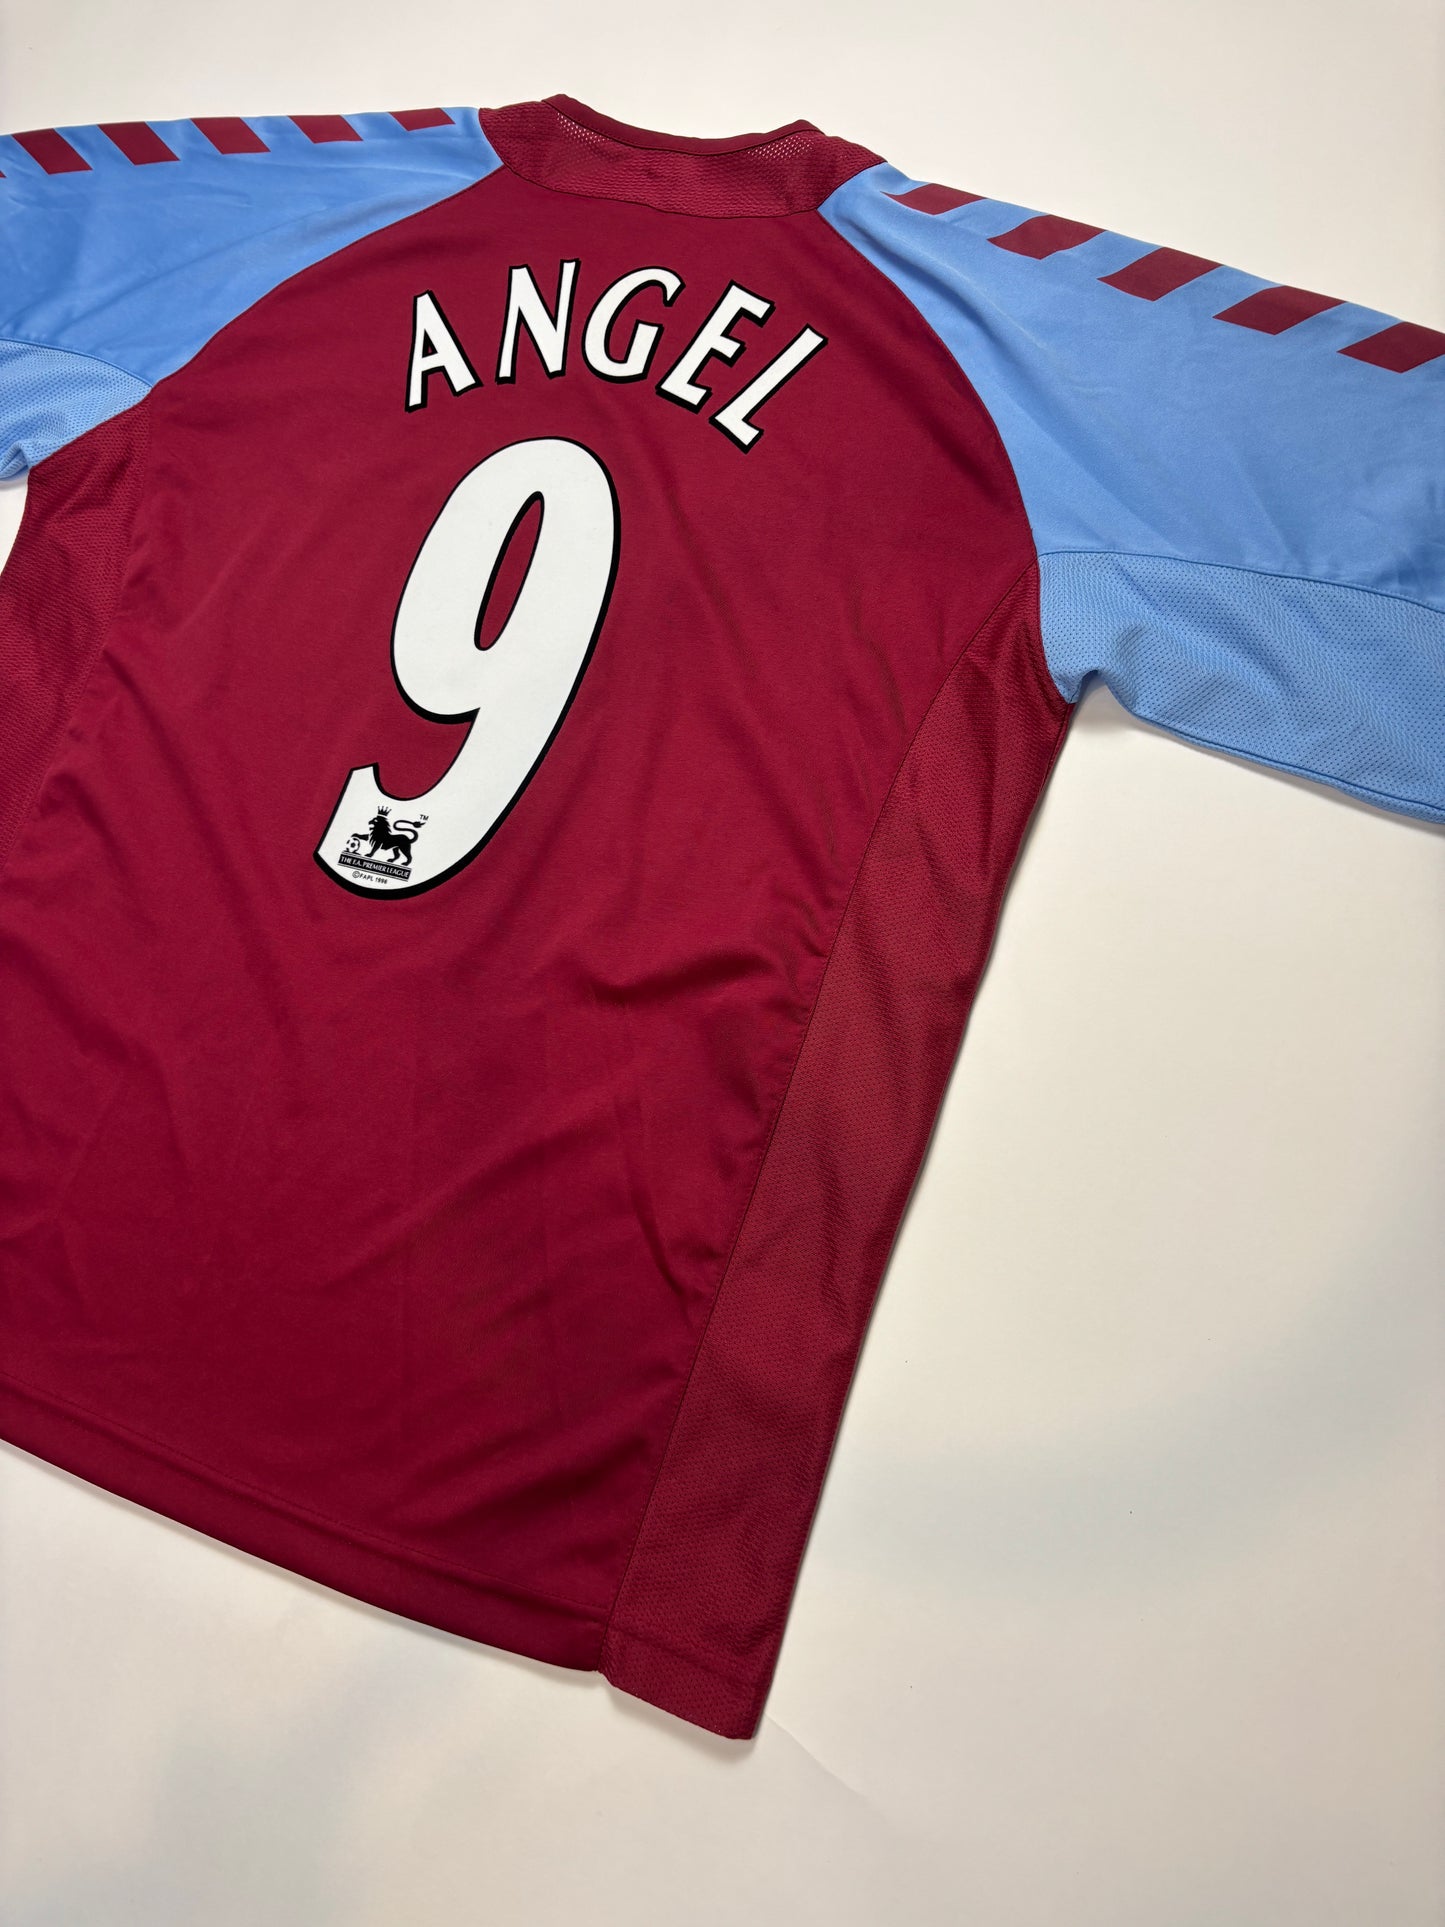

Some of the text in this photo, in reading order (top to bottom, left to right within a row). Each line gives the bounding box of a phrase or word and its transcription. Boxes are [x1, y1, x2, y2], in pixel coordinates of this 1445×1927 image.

[405, 258, 828, 454] ANGEL
[313, 435, 621, 900] 9
[341, 856, 352, 864] THE
[362, 861, 386, 872] PREMIER
[386, 867, 410, 878] LEAGUE
